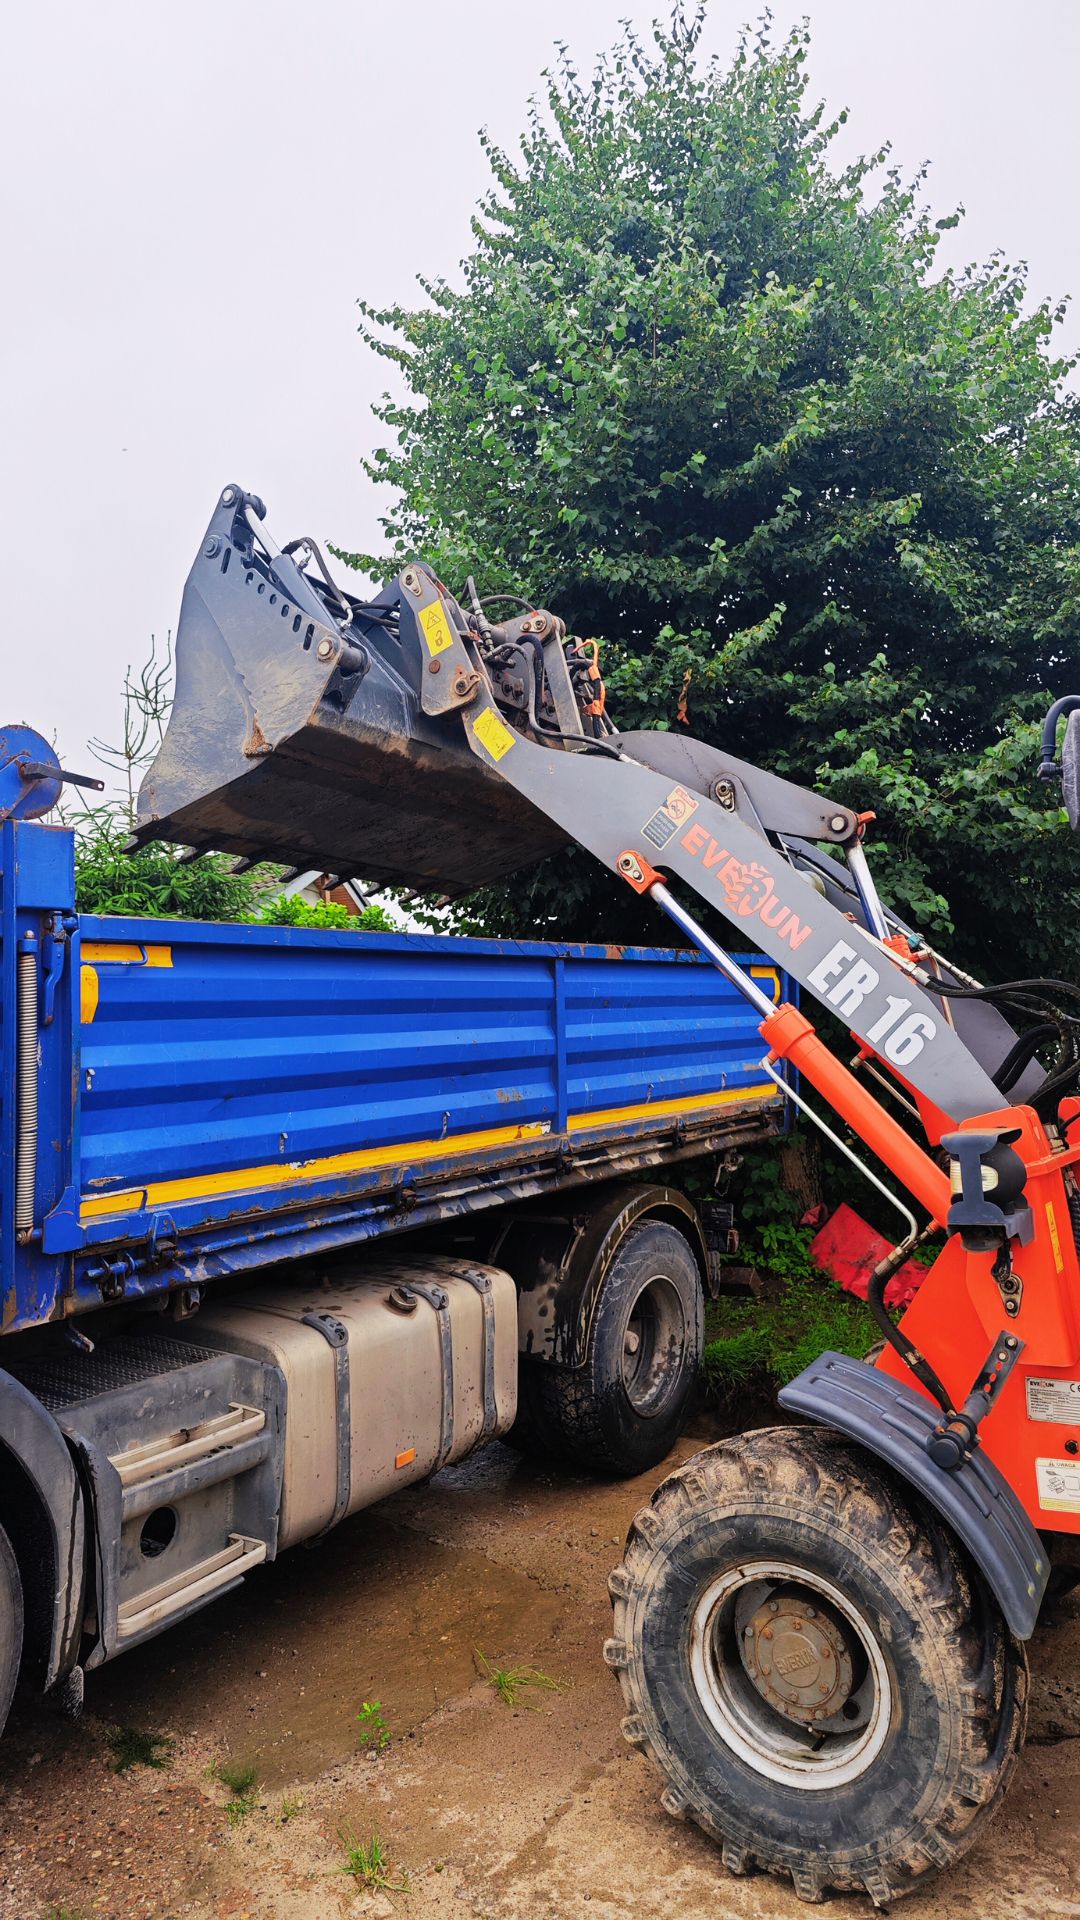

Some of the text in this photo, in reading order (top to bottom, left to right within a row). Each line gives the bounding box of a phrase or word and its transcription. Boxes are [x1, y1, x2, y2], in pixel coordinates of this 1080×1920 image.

[680, 823, 812, 951] EVERUN
[806, 939, 937, 1066] ER 16
[773, 1647, 818, 1676] EVERUN
